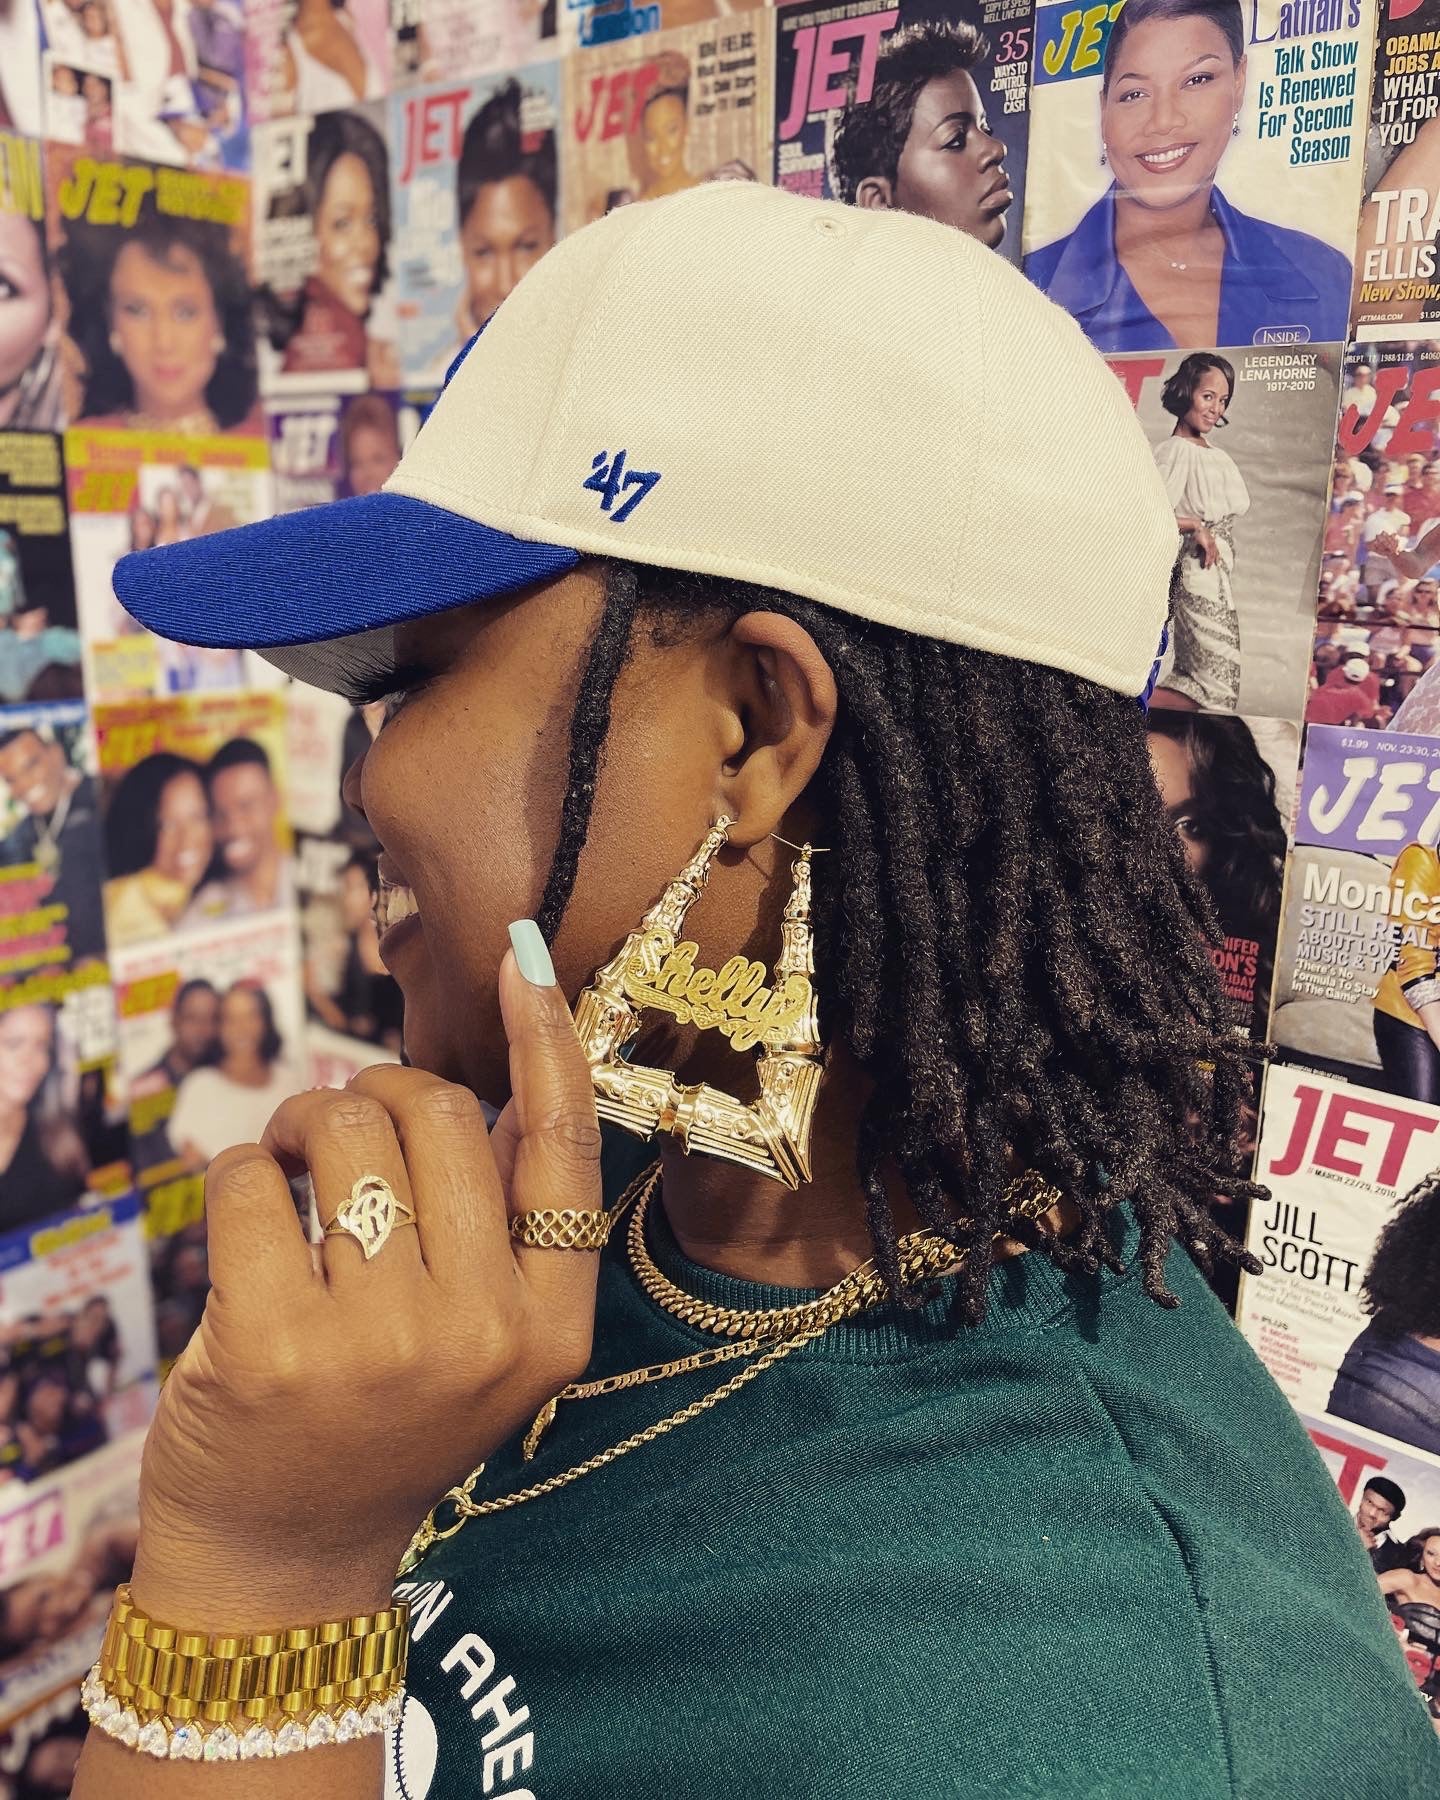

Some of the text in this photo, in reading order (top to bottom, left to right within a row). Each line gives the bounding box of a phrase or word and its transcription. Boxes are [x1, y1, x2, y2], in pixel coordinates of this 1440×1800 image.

[1002, 9, 1015, 20] LIVE
[1016, 6, 1031, 17] RICH
[1249, 0, 1361, 45] Latifahs
[995, 28, 1030, 63] 35
[1274, 41, 1359, 77] Talk Show
[779, 10, 899, 141] JET
[994, 62, 1028, 79] WAYS TO
[1384, 55, 1429, 77] JOBS
[990, 75, 1028, 92] CONTROL
[1005, 87, 1027, 102] YOUR
[1259, 68, 1357, 109] Is Renewed
[574, 63, 660, 144] JET
[1003, 100, 1026, 115] CASH
[1258, 99, 1353, 139] For Second
[1380, 95, 1439, 124] IT FOR
[401, 90, 474, 184] JET
[1379, 122, 1417, 147] YOU
[1289, 135, 1351, 166] Season
[58, 157, 154, 229] JET
[1363, 245, 1437, 282] ELLIS
[1360, 284, 1393, 302] New
[1358, 313, 1404, 322] JETMAG.COM
[1240, 367, 1317, 381] LENA HORNE
[1244, 354, 1318, 368] LEGENDARY
[1266, 381, 1315, 392] 1917-2010
[1341, 738, 1369, 749] $1.99
[1376, 742, 1398, 753] NOV.
[1399, 744, 1430, 757] 23-30,
[1300, 904, 1434, 951] STILL REAL
[1297, 944, 1394, 976] MUSIC & TV
[1299, 929, 1405, 965] ABOUT LOVE,
[1291, 980, 1303, 992] In
[1303, 983, 1323, 996] The
[1293, 969, 1380, 1000] Formula To Stay
[1338, 967, 1354, 980] No
[1269, 1084, 1440, 1187] JET
[1315, 1168, 1343, 1184] MARCH
[1375, 1184, 1398, 1199] 2010
[1264, 1201, 1323, 1246] JILL
[1261, 1235, 1359, 1292] SCOTT
[440, 1633, 537, 1800] AHE
